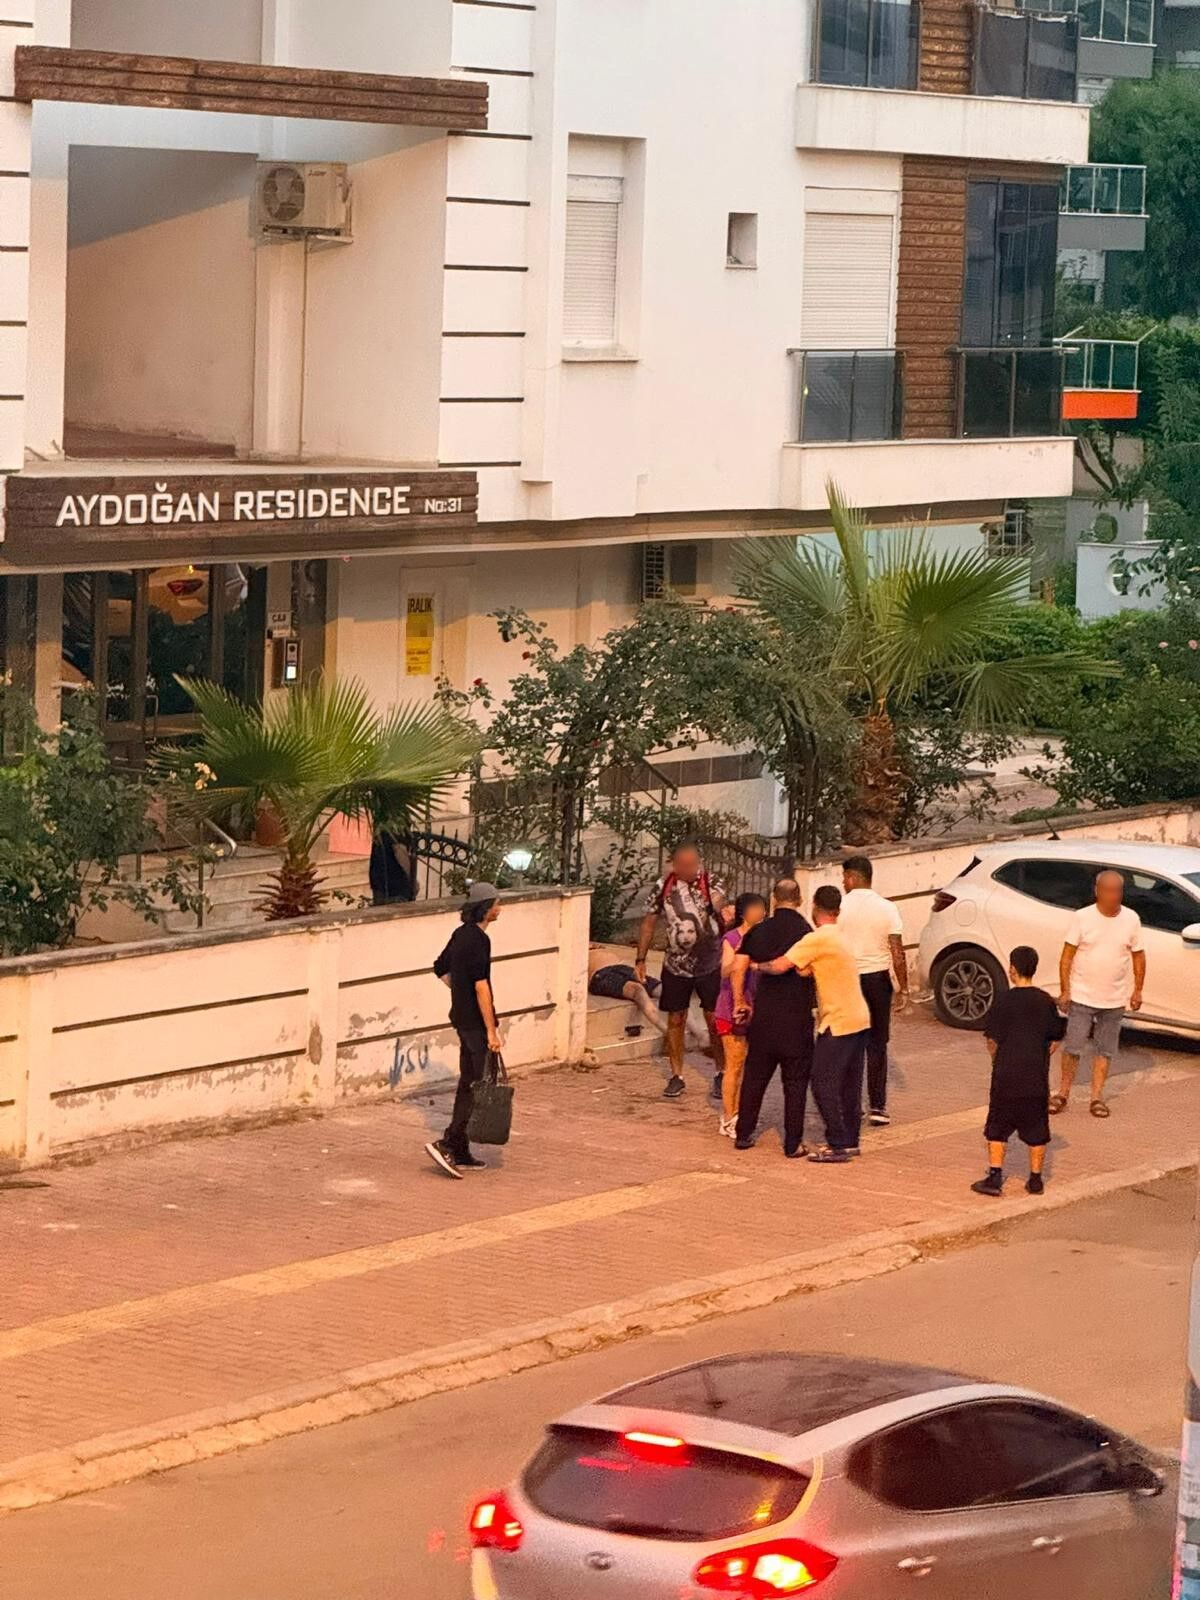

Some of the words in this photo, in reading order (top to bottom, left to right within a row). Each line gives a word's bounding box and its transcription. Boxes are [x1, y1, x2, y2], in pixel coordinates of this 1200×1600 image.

[56, 482, 220, 527] AYDOĞAN
[233, 486, 411, 520] RESIDENCE
[424, 497, 462, 514] No:31
